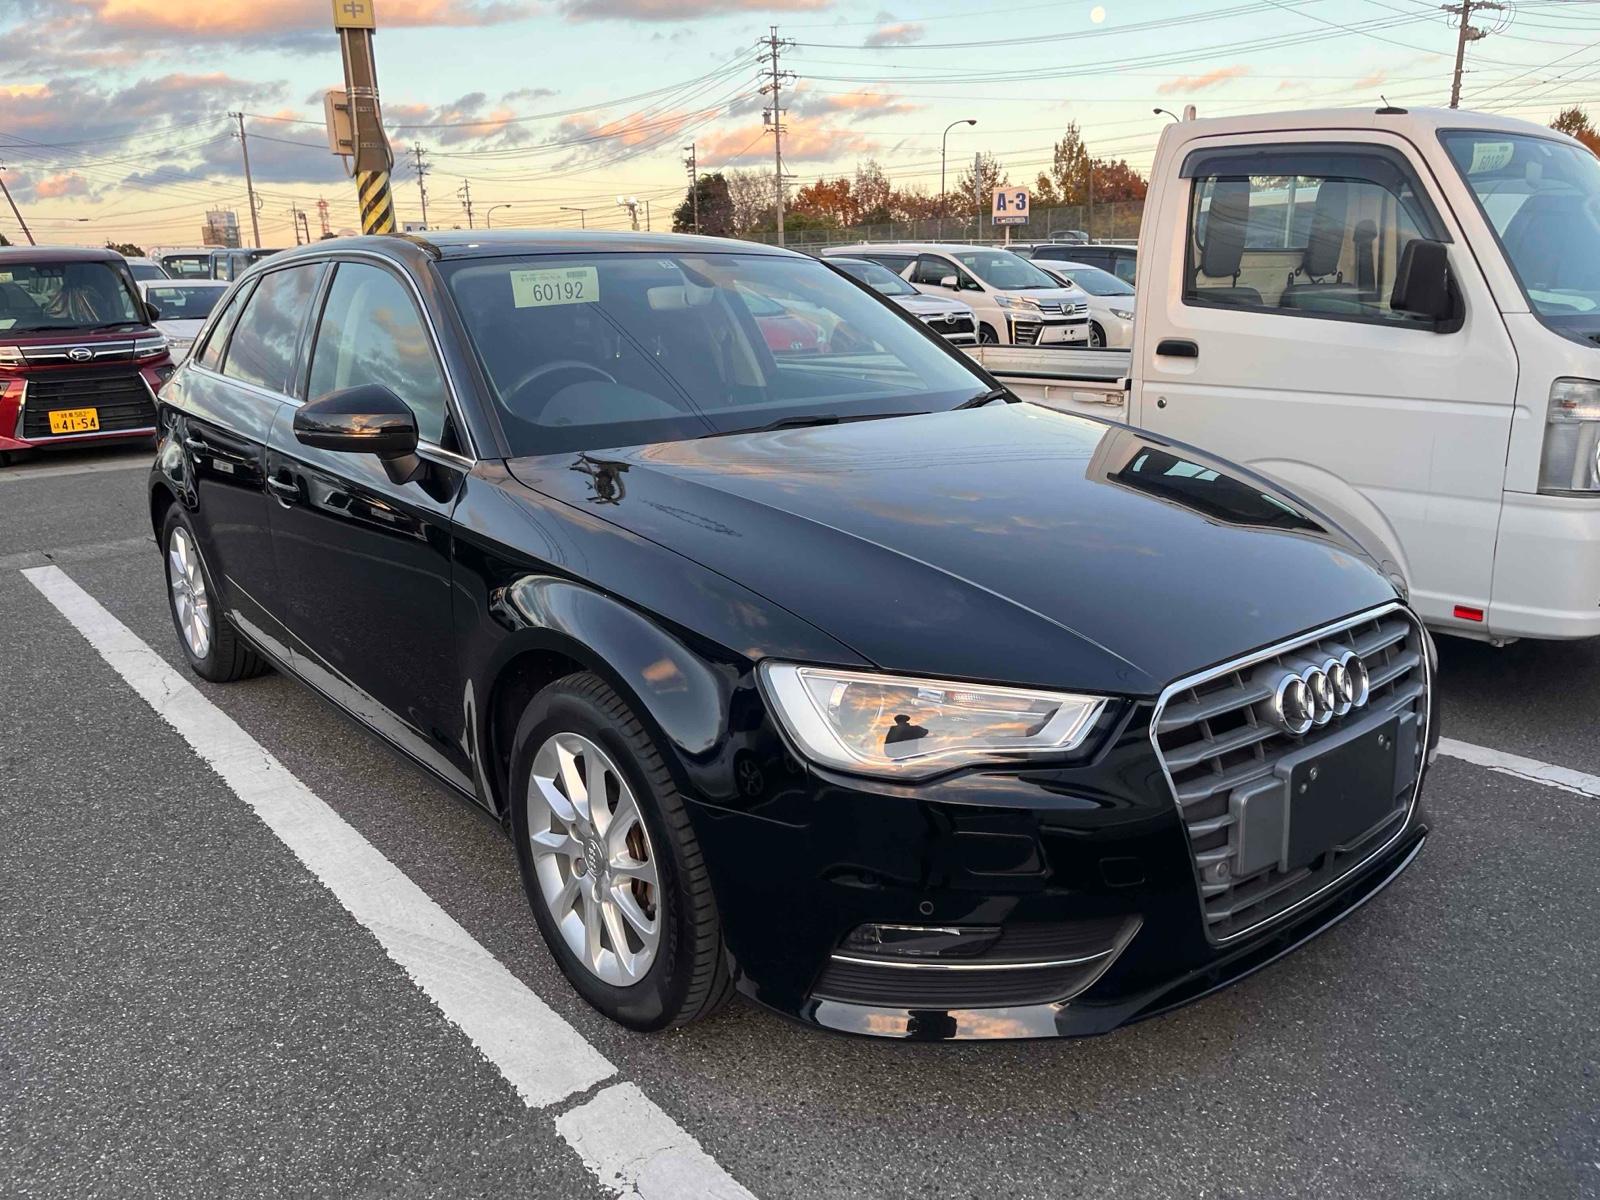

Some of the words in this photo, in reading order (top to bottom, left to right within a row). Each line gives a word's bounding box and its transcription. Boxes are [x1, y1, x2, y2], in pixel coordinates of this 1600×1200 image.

[343, 1, 364, 19] 中
[996, 193, 1026, 211] A-3
[533, 281, 584, 302] 60192
[62, 417, 96, 431] 41-54
